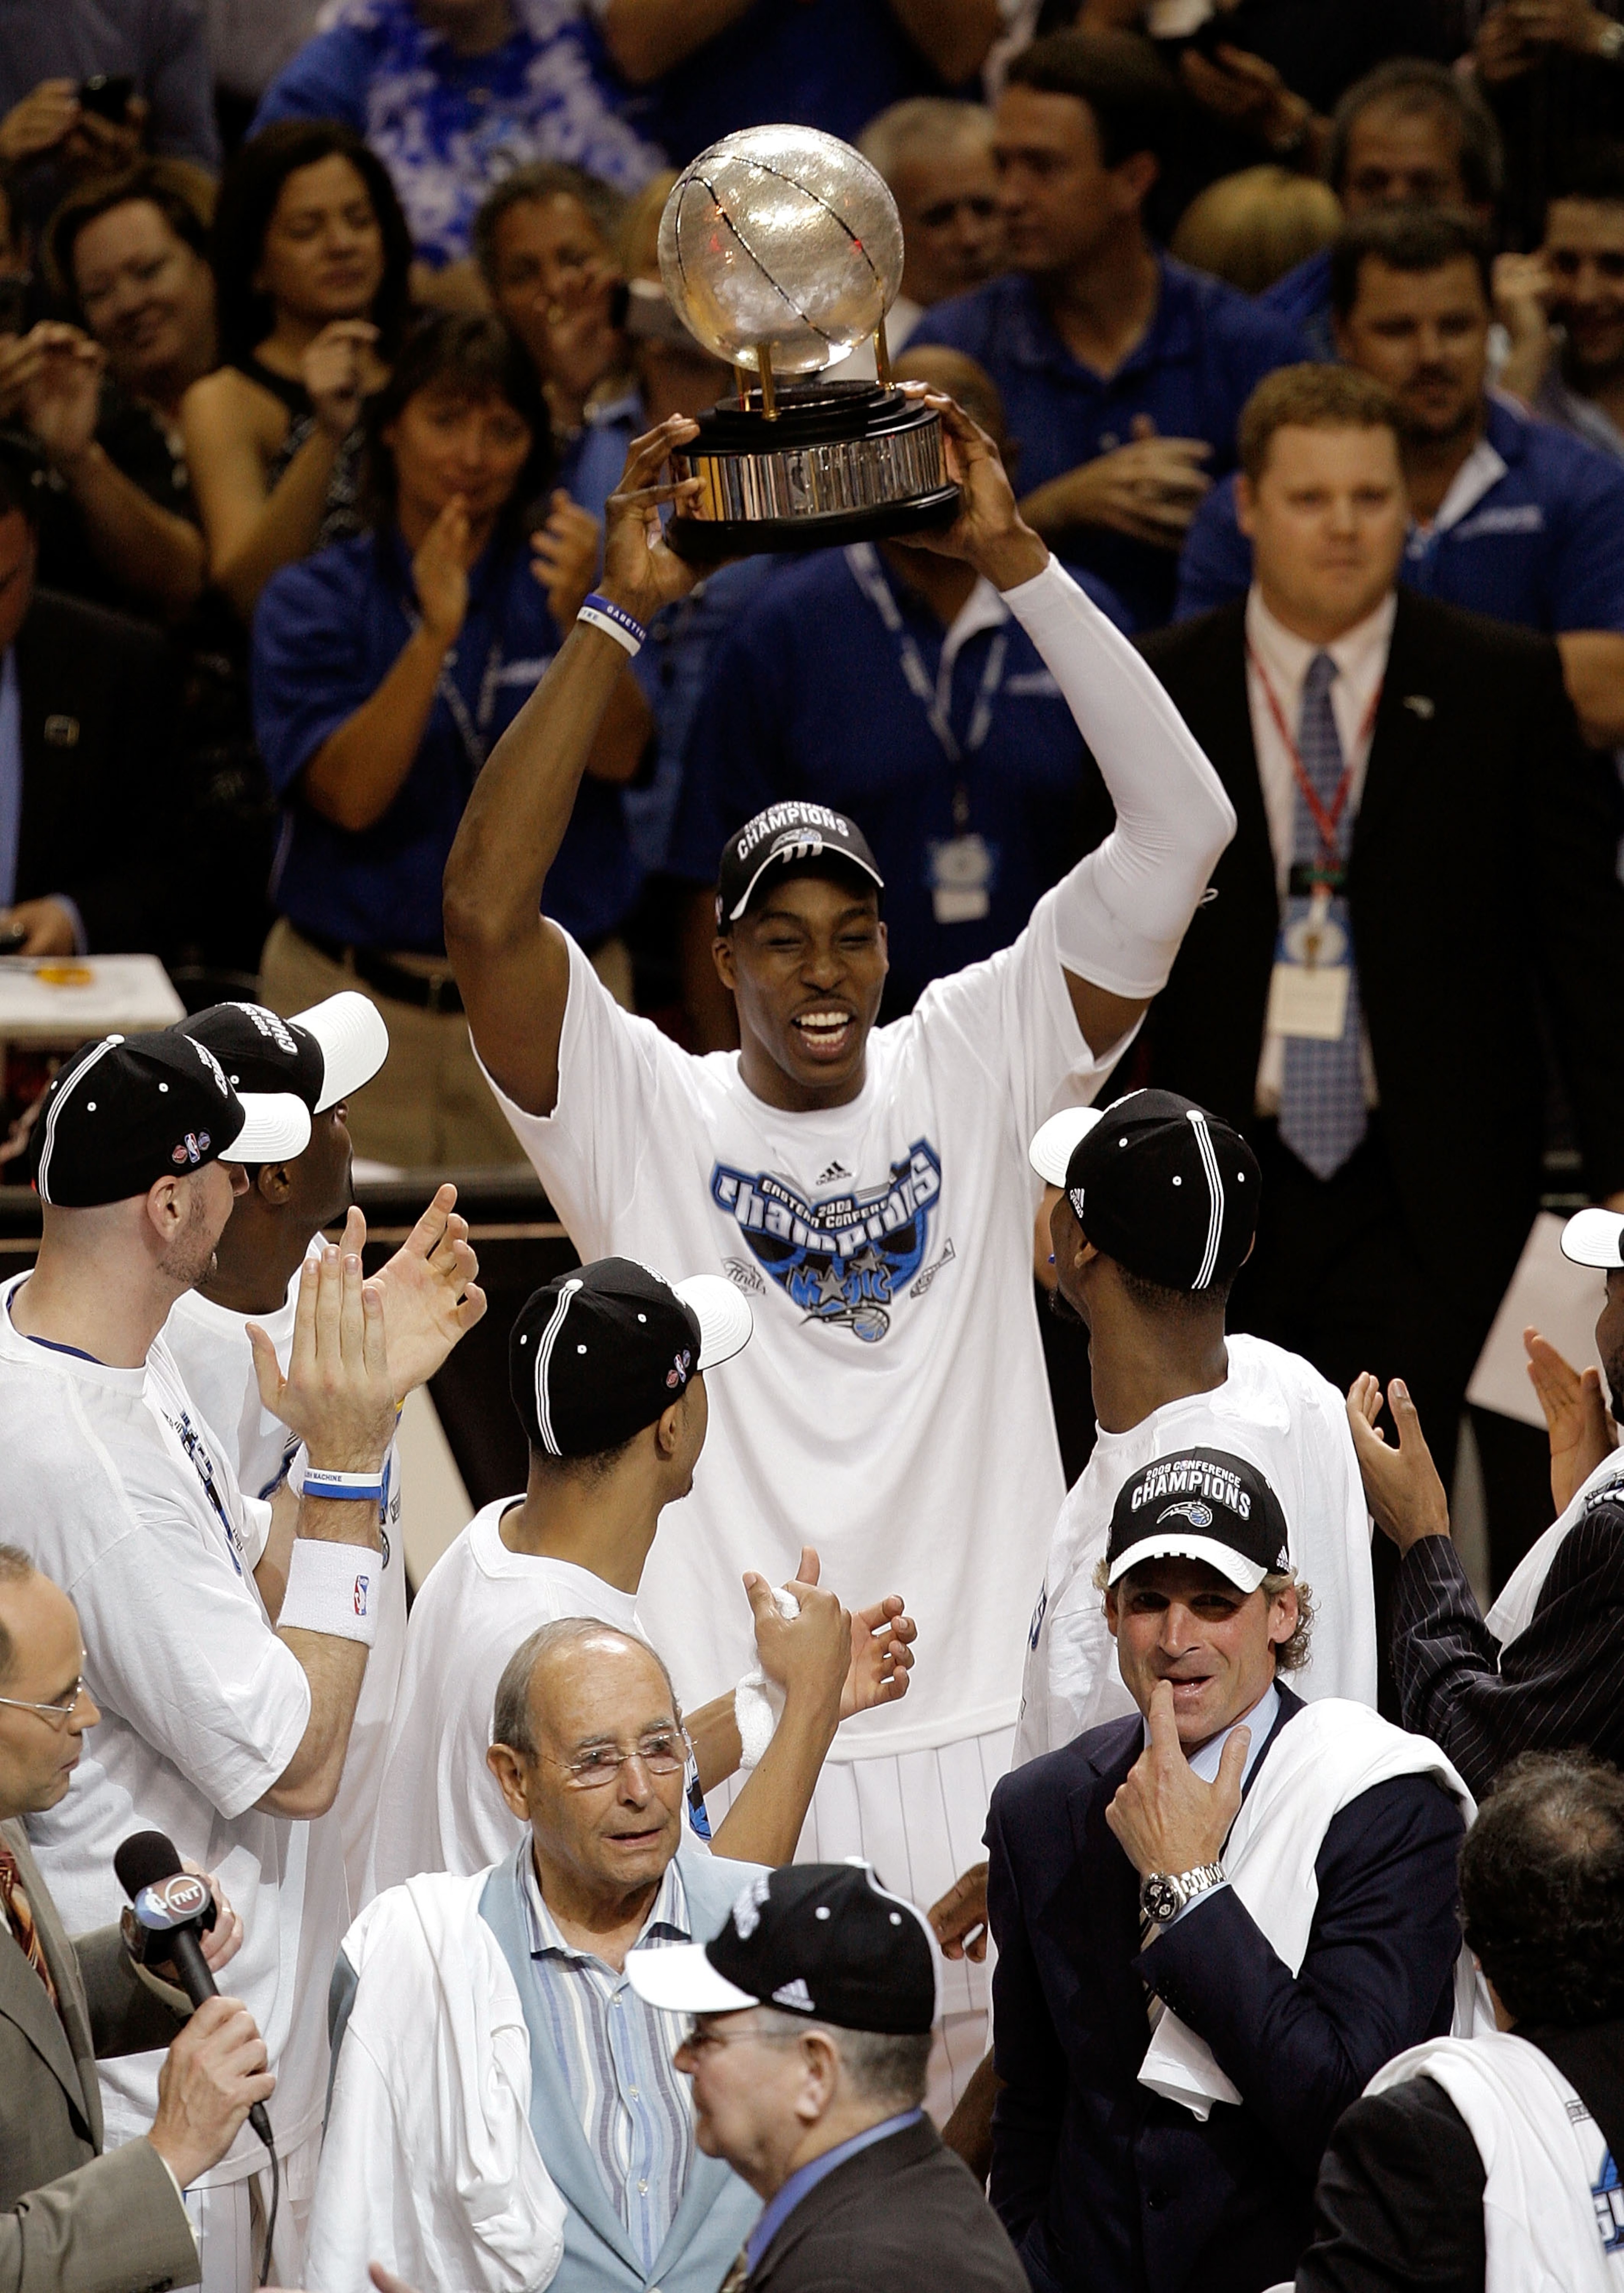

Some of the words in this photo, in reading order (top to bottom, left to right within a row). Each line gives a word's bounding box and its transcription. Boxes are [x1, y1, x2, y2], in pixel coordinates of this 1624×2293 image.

[737, 807, 849, 861] CHAMPIONS
[313, 1473, 342, 1481] MACHINE
[1146, 1463, 1171, 1481] 2009
[1131, 1471, 1251, 1520] CHAMPIONS
[170, 1886, 199, 1905] TNT
